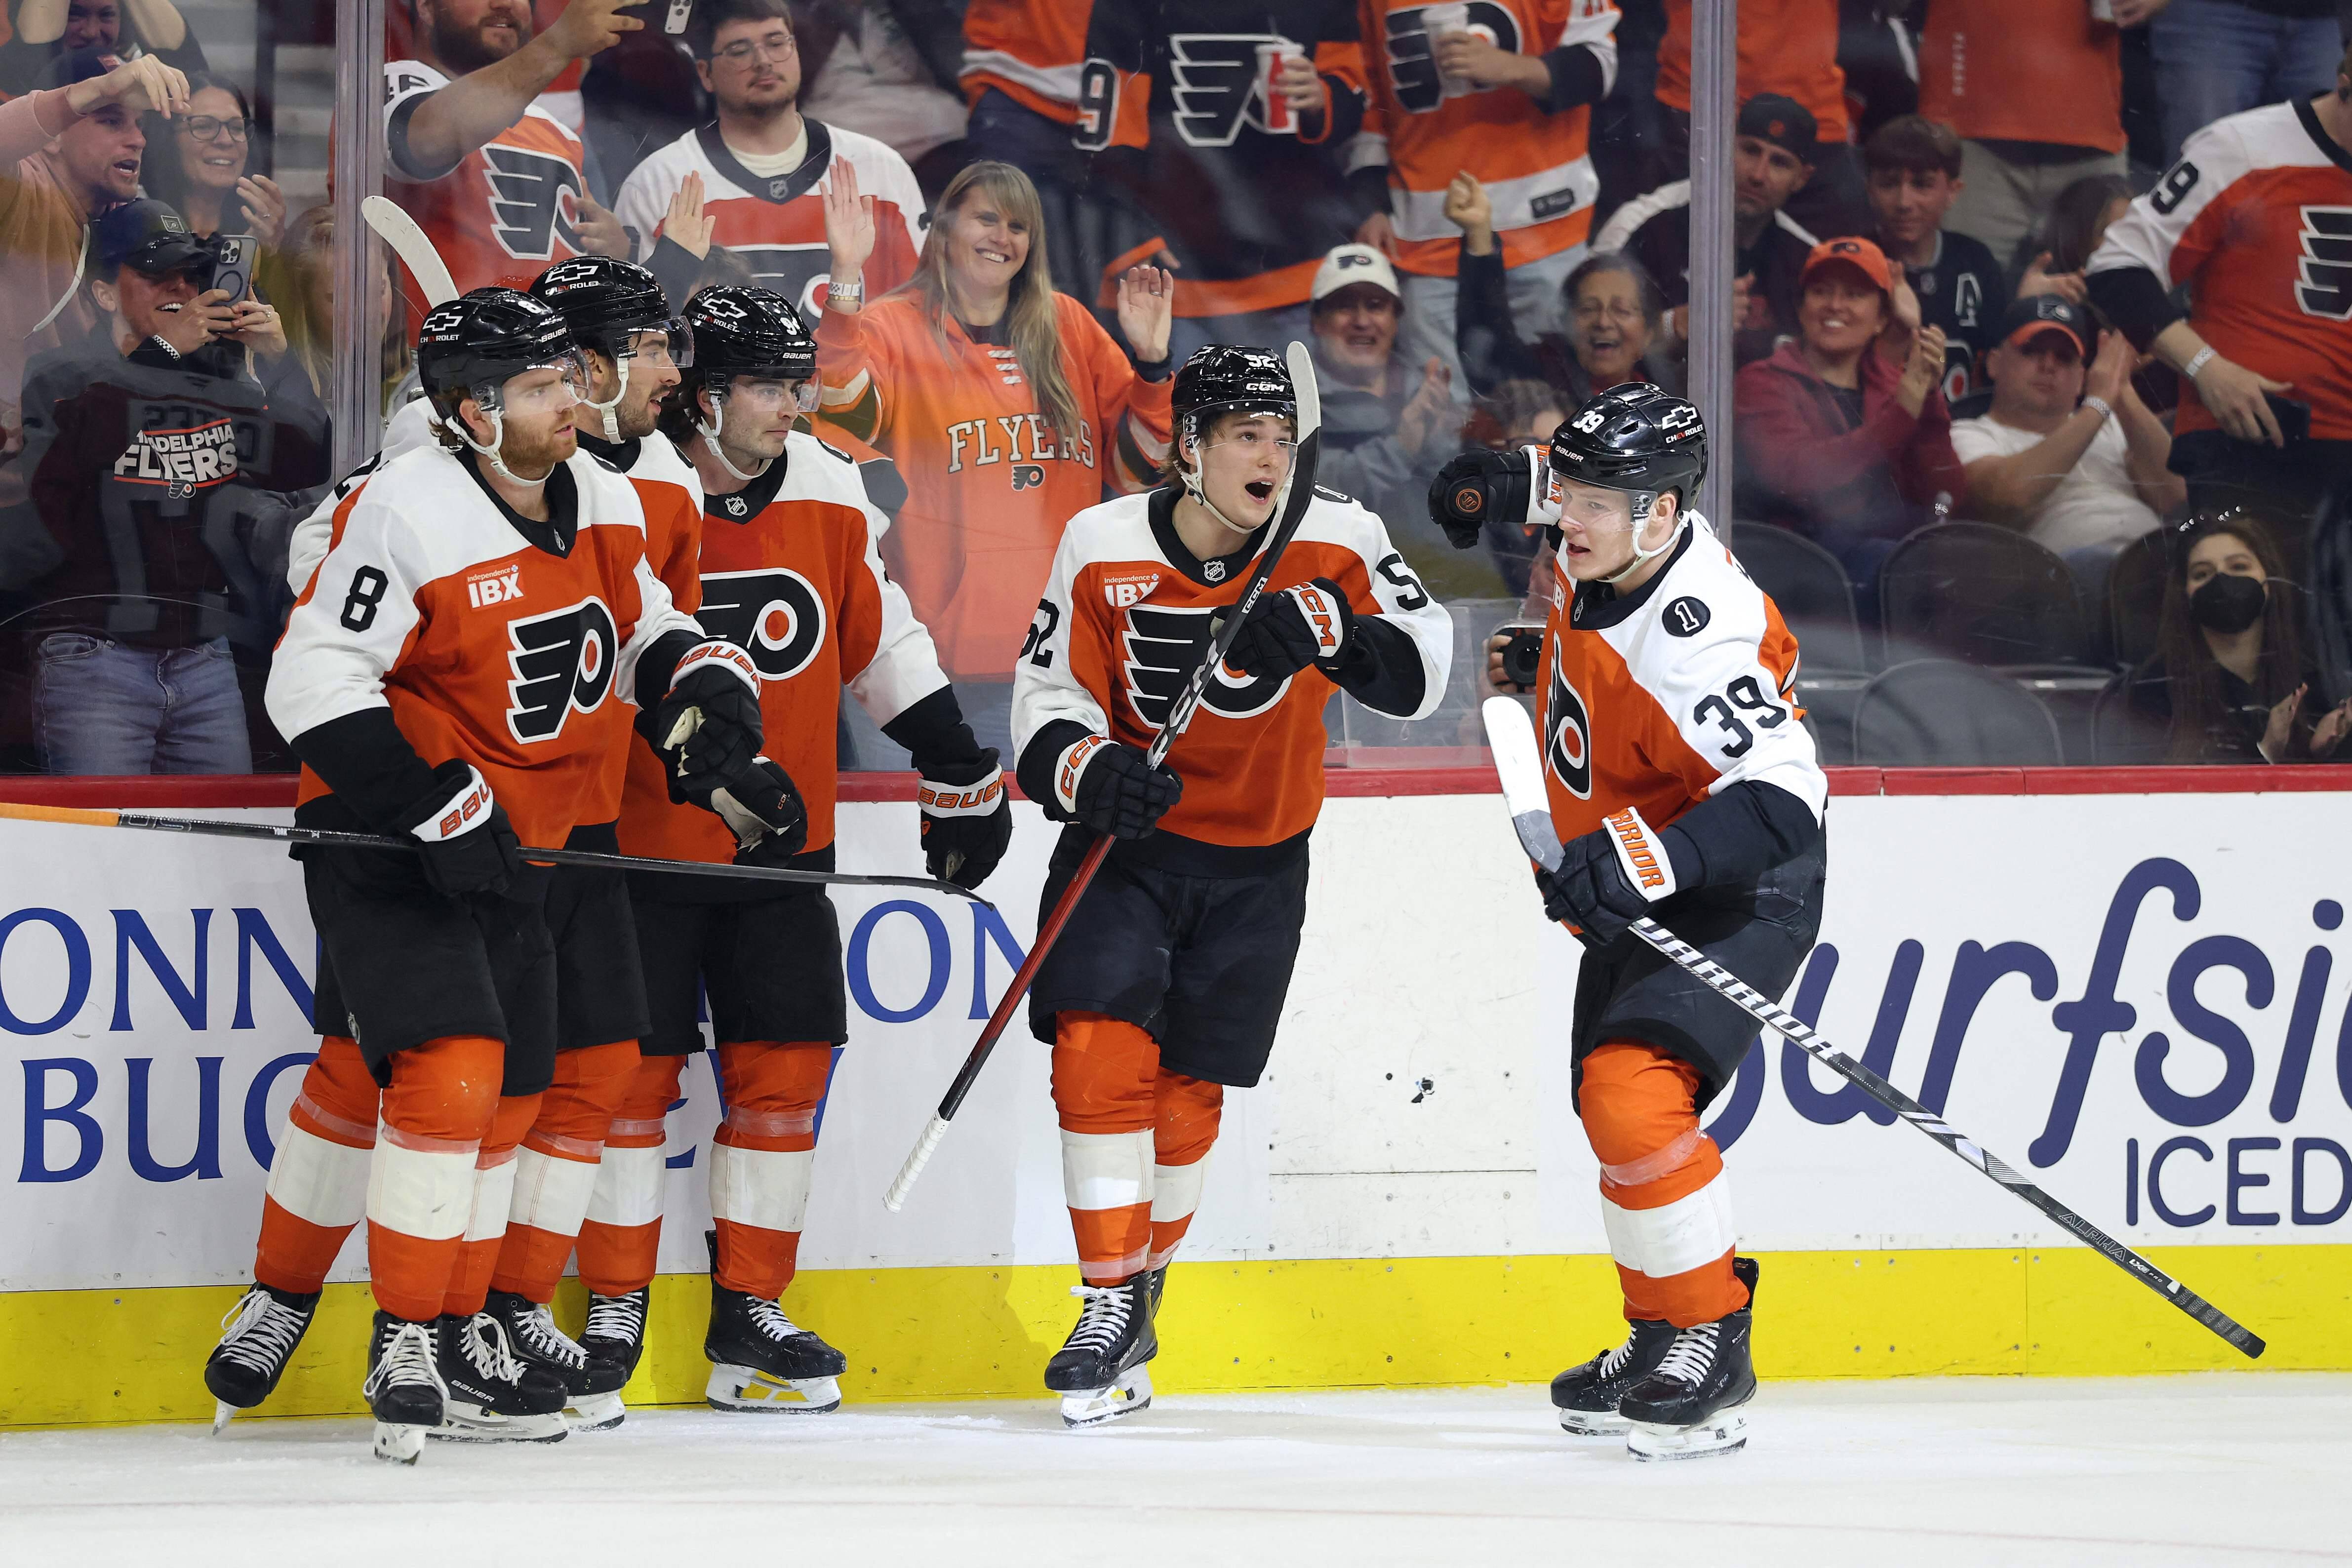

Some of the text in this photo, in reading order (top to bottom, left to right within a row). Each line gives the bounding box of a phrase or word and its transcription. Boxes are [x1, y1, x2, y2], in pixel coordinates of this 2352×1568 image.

[541, 327, 567, 343] BAUER
[697, 313, 739, 332] CHEVROLET
[420, 334, 460, 344] CHEVROLET
[1243, 354, 1277, 368] 52
[1245, 383, 1285, 392] CCM
[1571, 410, 1604, 433] 39
[1665, 424, 1704, 444] CHEVROLET
[114, 442, 238, 482] FLYERS
[1555, 444, 1584, 463] BAUER
[467, 567, 511, 582] Independence
[1104, 574, 1151, 585] Independence
[340, 565, 389, 632] 8
[468, 573, 524, 608] IBX
[1244, 579, 1266, 612] CCM
[1674, 600, 1700, 632] 1
[1693, 674, 1788, 759] 39
[440, 780, 491, 839] BAU
[1607, 808, 1665, 889] RRIOR
[1702, 857, 2352, 1168] urfsi
[2126, 1135, 2352, 1227] ICED
[2058, 1213, 2126, 1262] ALPHA
[2149, 1272, 2163, 1283] PRO
[1118, 1337, 1140, 1368] BAUER
[450, 1379, 495, 1403] BAUER
